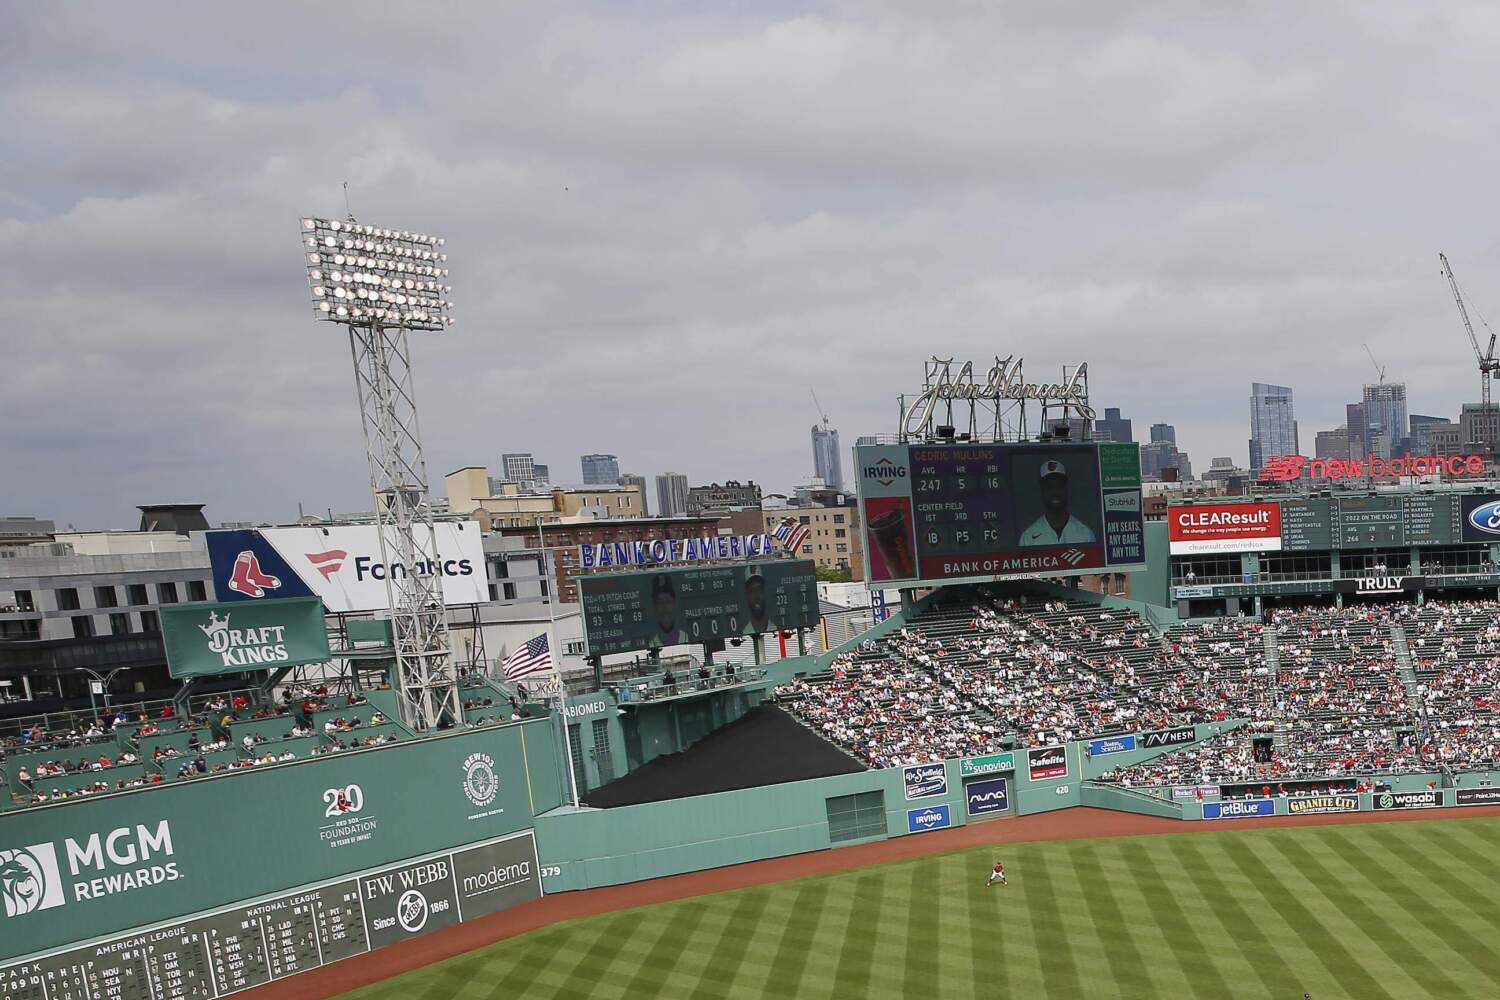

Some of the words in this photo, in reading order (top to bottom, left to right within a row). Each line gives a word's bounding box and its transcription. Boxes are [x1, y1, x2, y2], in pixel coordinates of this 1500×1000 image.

[980, 354, 1096, 420] Hancock
[1310, 459, 1364, 480] new
[1368, 451, 1484, 478] balance
[864, 466, 906, 479] IRVING
[917, 479, 941, 492] .247
[959, 478, 966, 490] 5
[987, 477, 999, 489] 16
[917, 503, 943, 512] CENTER
[945, 502, 964, 511] FIELD
[1178, 510, 1269, 526] CLEAResult
[1107, 522, 1119, 533] ANY
[983, 529, 998, 541] FC
[1109, 535, 1121, 545] ANY
[580, 540, 645, 568] BANK
[650, 538, 678, 564] OF
[683, 532, 774, 562] AMERICA
[1112, 547, 1125, 558] ANY
[1125, 545, 1140, 558] TIME
[943, 562, 979, 574] BANK
[982, 560, 1000, 571] OF
[1002, 556, 1060, 570] AMERICA
[1355, 577, 1403, 591] TRULY
[207, 625, 285, 653] DRAFT
[222, 644, 289, 667] KINGS
[563, 700, 606, 718] ABIOMED
[1170, 730, 1194, 742] NESN
[462, 752, 481, 772] IBEW
[481, 752, 495, 768] 103
[972, 760, 1012, 774] sunovion
[1029, 755, 1065, 768] Safelite
[1055, 785, 1069, 795] 420
[322, 784, 364, 818] 20
[969, 790, 1005, 803] nuna
[1394, 791, 1436, 804] wasabi
[1218, 802, 1259, 818] jetBlue
[1290, 797, 1334, 812] GRANITE
[1335, 796, 1358, 809] CITY
[915, 813, 943, 824] IRVING
[319, 820, 377, 841] FOUNDATION
[64, 819, 174, 876] MGM
[399, 860, 449, 889] WEBB
[463, 861, 531, 892] moderna
[541, 866, 561, 878] 379
[73, 862, 179, 902] REWARDS
[247, 901, 288, 917] NATIONAL
[290, 891, 321, 907] LEAGUE
[329, 907, 341, 917] PIT
[373, 915, 396, 931] Since
[430, 899, 450, 914] 1866
[278, 920, 292, 931] LAD
[332, 915, 341, 924] SD
[331, 923, 345, 933] CHC
[96, 936, 146, 956] AMERICAN
[150, 926, 187, 942] LEAGUE
[225, 935, 238, 946] PHI
[281, 930, 293, 940] ARI
[332, 931, 346, 941] CWS
[225, 943, 241, 954] NYM
[282, 939, 294, 949] MIL
[283, 946, 296, 955] STL
[162, 952, 178, 962] TEX
[228, 953, 242, 963] COL
[285, 955, 297, 964] MIA
[164, 960, 179, 970] OAK
[228, 960, 244, 970] WSH
[286, 962, 299, 972] ATL
[47, 971, 55, 980] R
[60, 968, 67, 977] H
[72, 965, 79, 974] E
[102, 967, 120, 978] HOU
[165, 969, 181, 979] TOR
[233, 969, 242, 979] SF
[30, 975, 40, 985] 10
[104, 976, 120, 987] SEA
[167, 977, 182, 988] LAA
[233, 977, 246, 987] CIN
[107, 985, 122, 996] NYY
[171, 987, 183, 997] KC
